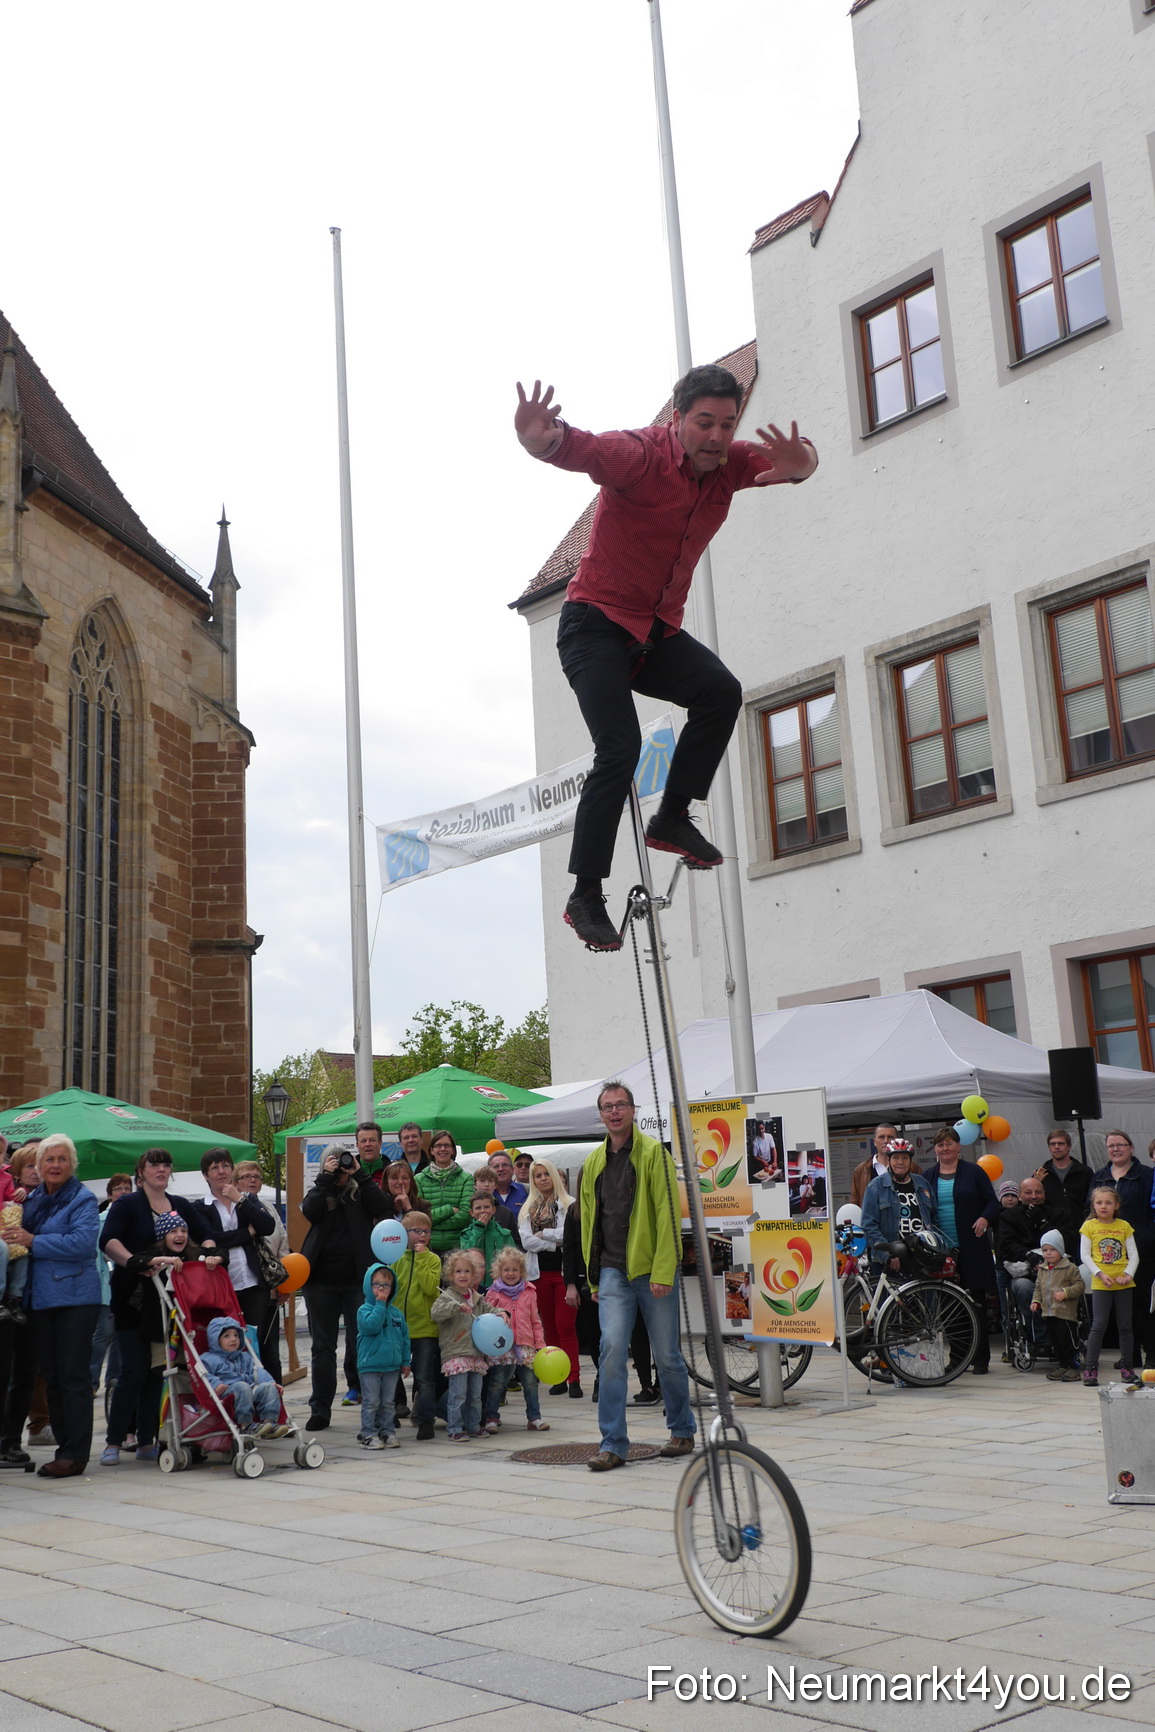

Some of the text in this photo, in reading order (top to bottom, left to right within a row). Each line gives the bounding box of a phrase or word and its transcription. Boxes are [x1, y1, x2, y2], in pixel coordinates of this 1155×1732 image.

[424, 802, 515, 842] Sozialraum
[528, 768, 594, 815] Neuma
[687, 1101, 741, 1114] MPATHIEBLUME
[703, 1202, 740, 1210] EHINDERUNG
[755, 1222, 824, 1232] SYMPATHIEBLUME
[771, 1319, 783, 1327] FÜR
